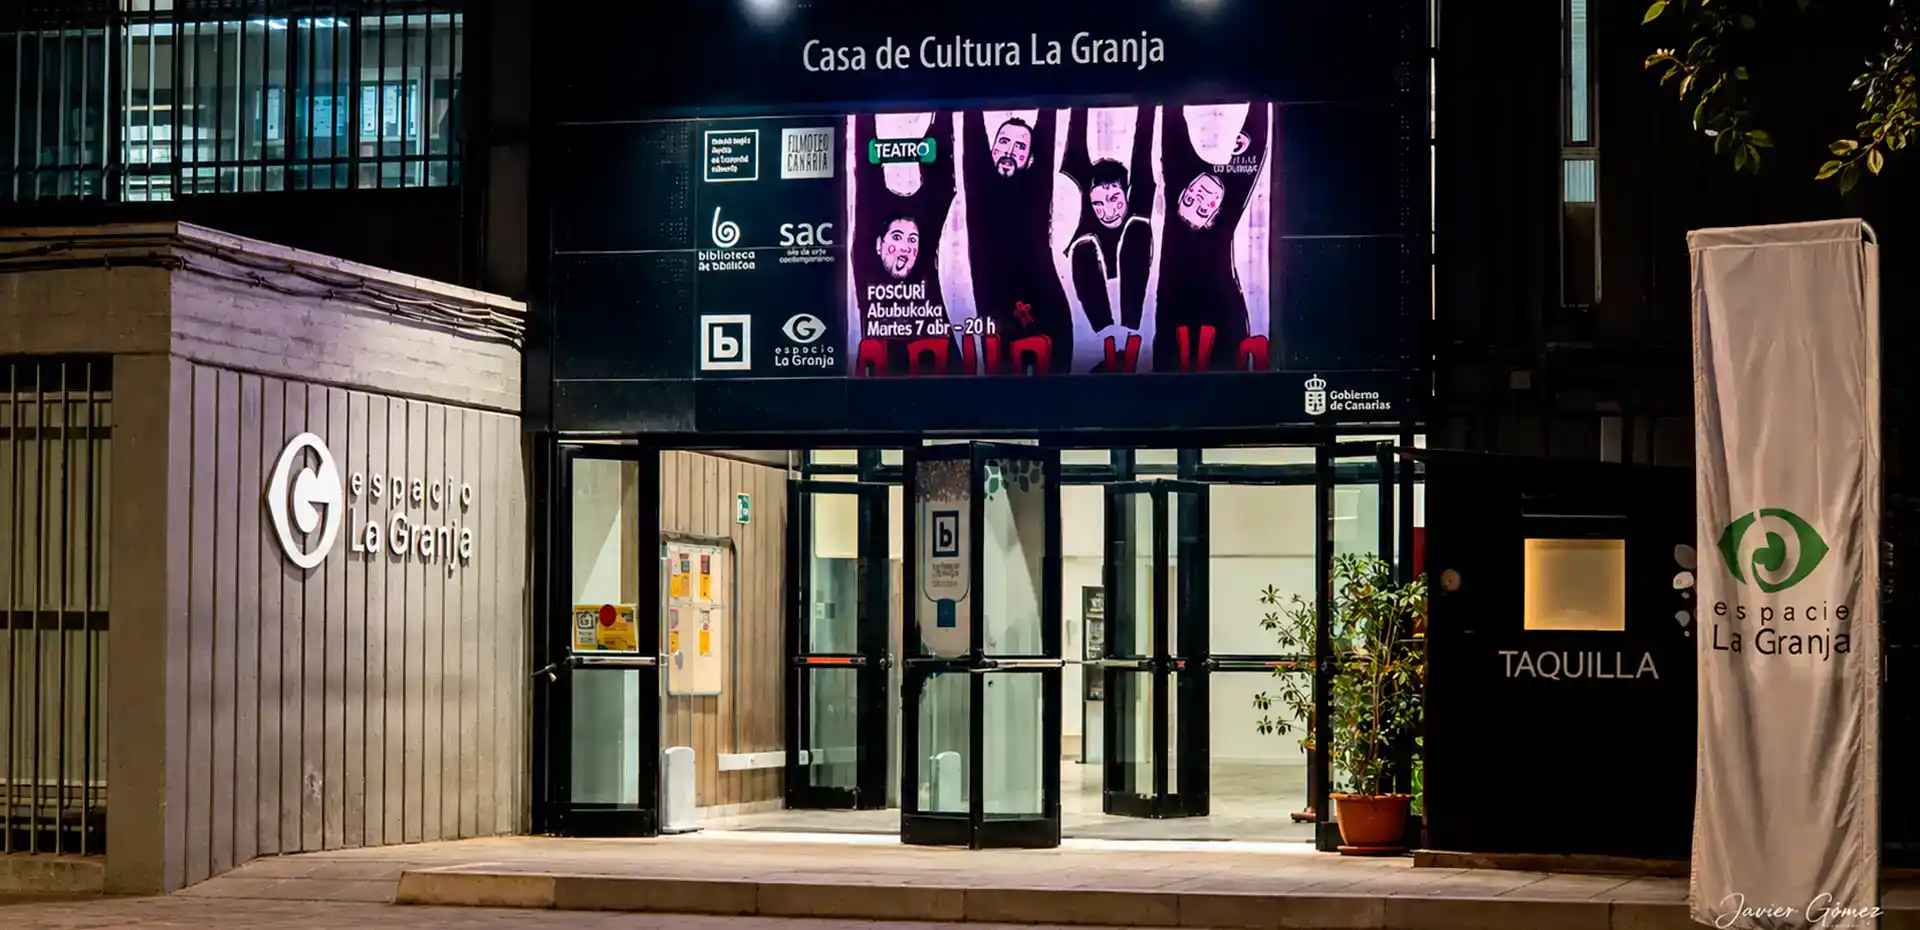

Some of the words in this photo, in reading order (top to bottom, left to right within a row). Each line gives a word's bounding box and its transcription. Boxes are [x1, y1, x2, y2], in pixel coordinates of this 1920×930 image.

[802, 39, 866, 72] Casa
[875, 36, 910, 69] de
[919, 34, 1020, 68] Cultura
[1031, 32, 1061, 66] La
[1071, 31, 1165, 71] Granja
[874, 141, 930, 158] TEATRO
[779, 222, 834, 246] sac
[698, 250, 756, 261] biblioteca
[867, 300, 943, 318] Abubukaka
[867, 320, 913, 336] Martes
[915, 319, 925, 335] 7
[926, 319, 951, 335] abr
[965, 318, 984, 334] 20
[986, 316, 996, 334] h
[774, 344, 834, 354] espacio
[774, 355, 790, 366] La
[791, 354, 834, 368] Granja
[1329, 390, 1379, 400] Gobierno
[1329, 401, 1343, 411] de
[1344, 400, 1391, 410] Canarias
[351, 472, 472, 509] espacio
[351, 507, 380, 553] La
[389, 511, 472, 570] Granja
[1713, 624, 1742, 653] La
[1755, 627, 1851, 662] Granja
[1499, 650, 1659, 680] TAQUILLA
